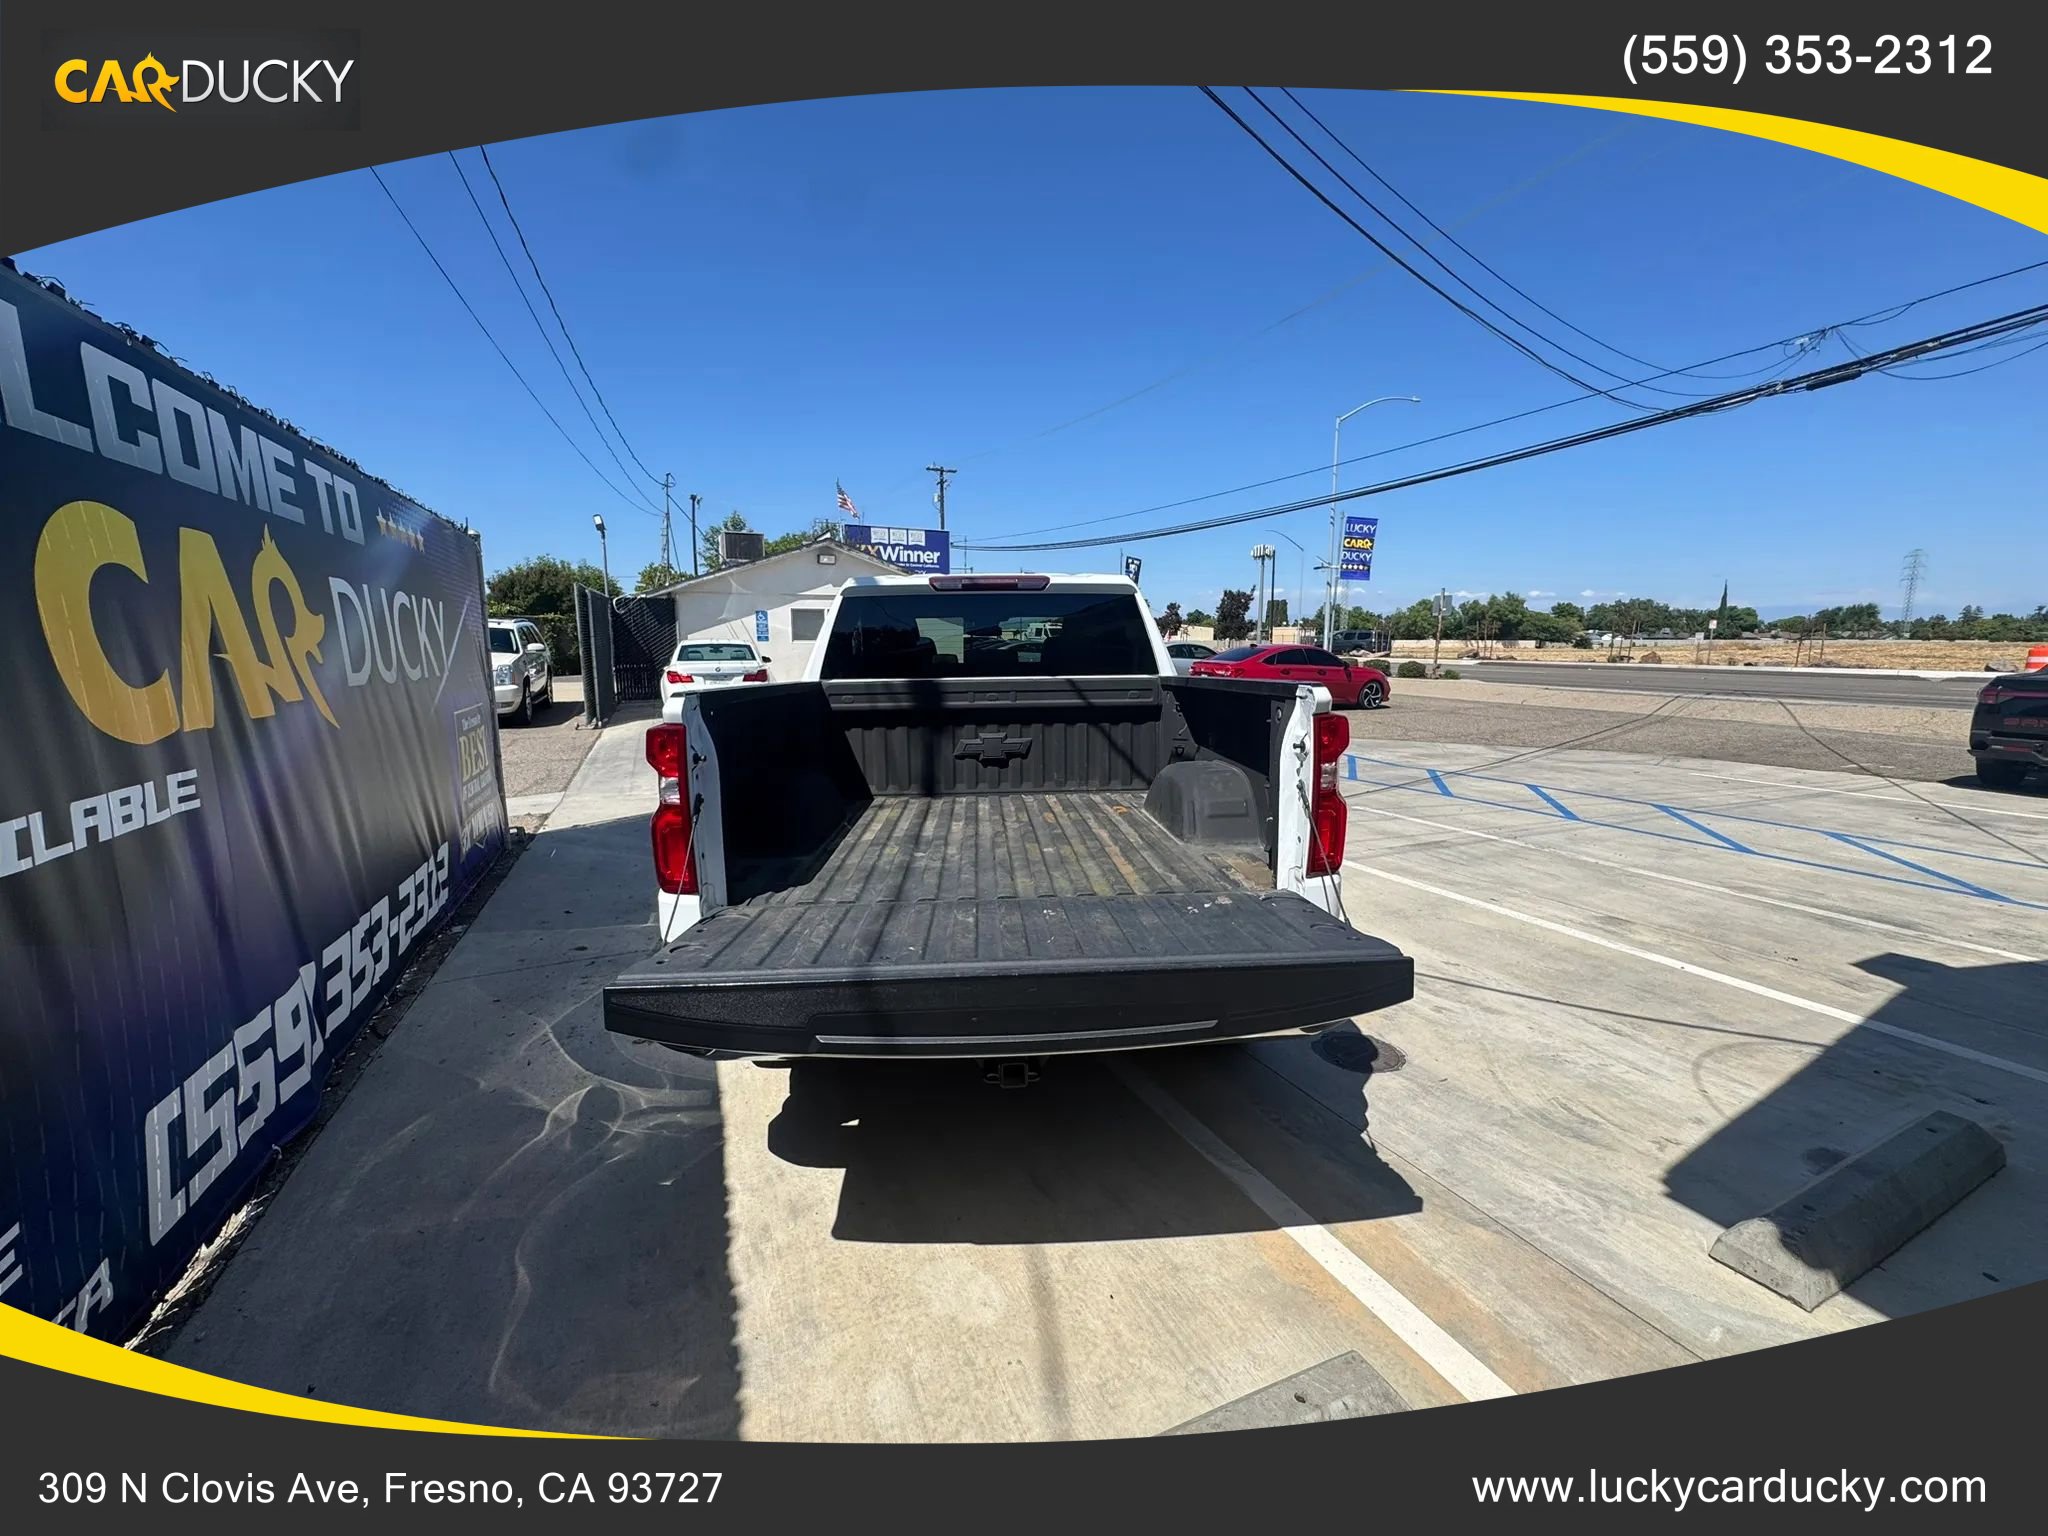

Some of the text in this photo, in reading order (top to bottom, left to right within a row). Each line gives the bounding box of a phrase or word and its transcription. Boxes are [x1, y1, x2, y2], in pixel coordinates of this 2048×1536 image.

[0, 298, 366, 547] LCOME TO
[879, 545, 941, 564] Winner
[1341, 551, 1372, 562] DUCKY
[1345, 523, 1377, 534] LUCKY
[34, 499, 449, 746] CAR DUCKY
[0, 769, 201, 878] ILABLE
[145, 841, 449, 1247] (559) 353-2312
